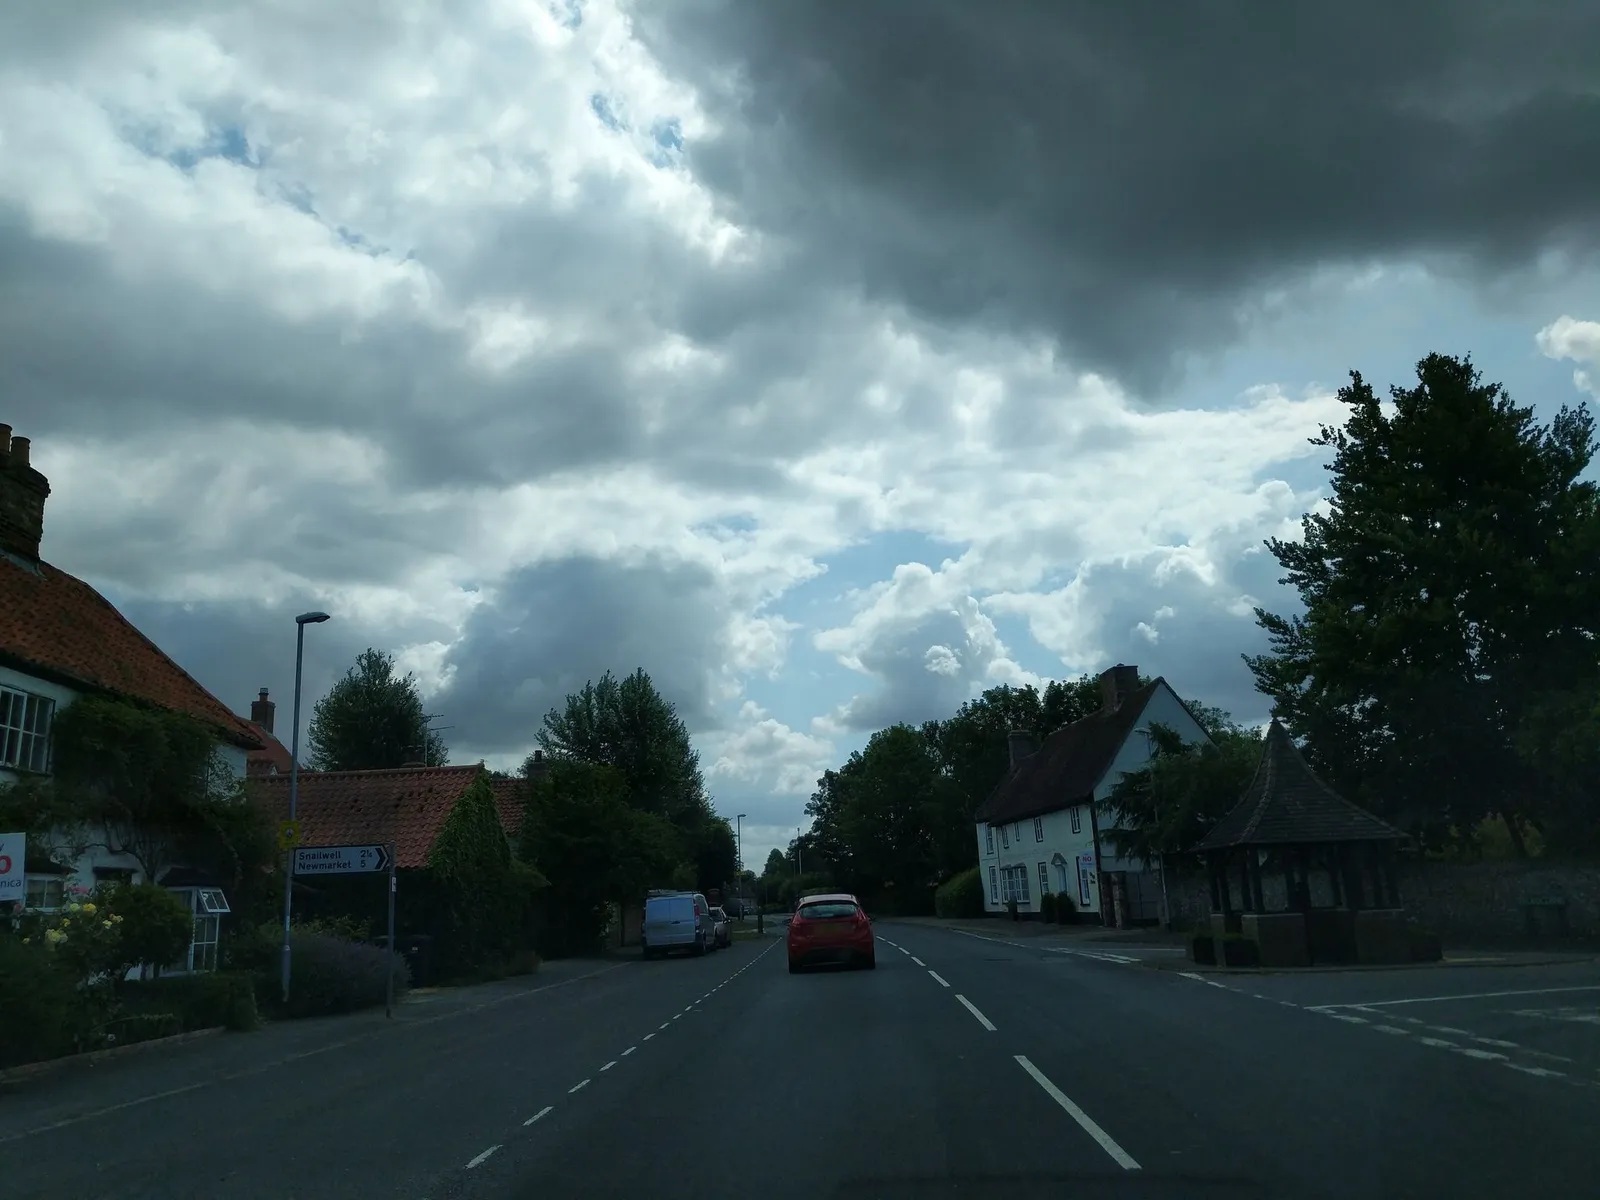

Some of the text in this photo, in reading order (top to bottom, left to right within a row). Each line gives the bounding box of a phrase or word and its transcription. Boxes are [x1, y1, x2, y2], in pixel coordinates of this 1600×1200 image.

[298, 850, 341, 861] Snailwell
[298, 859, 366, 870] Newmarket 5
